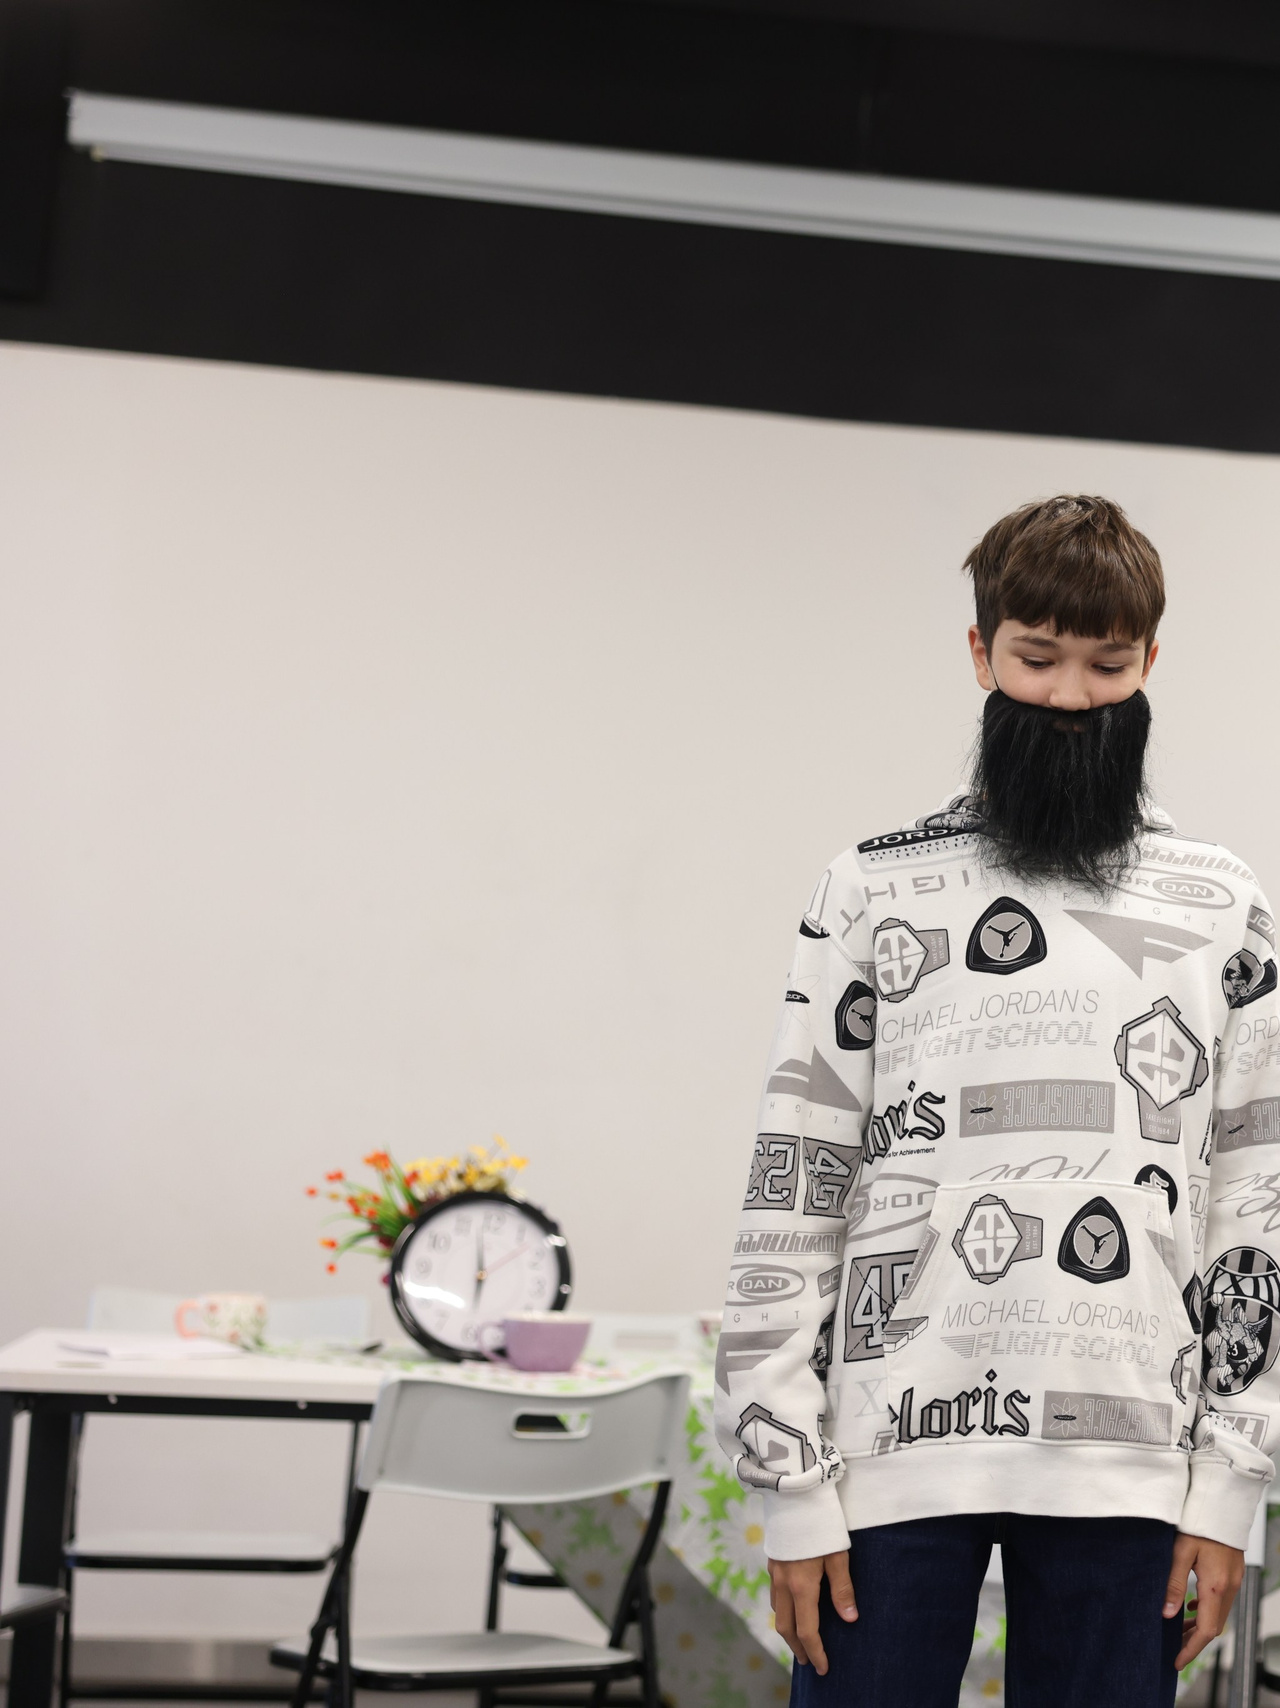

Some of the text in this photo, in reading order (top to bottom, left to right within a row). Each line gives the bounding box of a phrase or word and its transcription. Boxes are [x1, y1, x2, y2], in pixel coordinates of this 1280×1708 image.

[863, 829, 957, 849] JORD
[868, 840, 947, 857] PERFORMANCE
[896, 837, 978, 859] EXCELLENC
[877, 1002, 962, 1045] ICHAEL
[984, 1020, 1098, 1050] SCHOOL
[898, 1147, 936, 1157] Achievement
[941, 1299, 1050, 1329] MICHAEL
[973, 1330, 1159, 1370] FLIGHT SCHOOL
